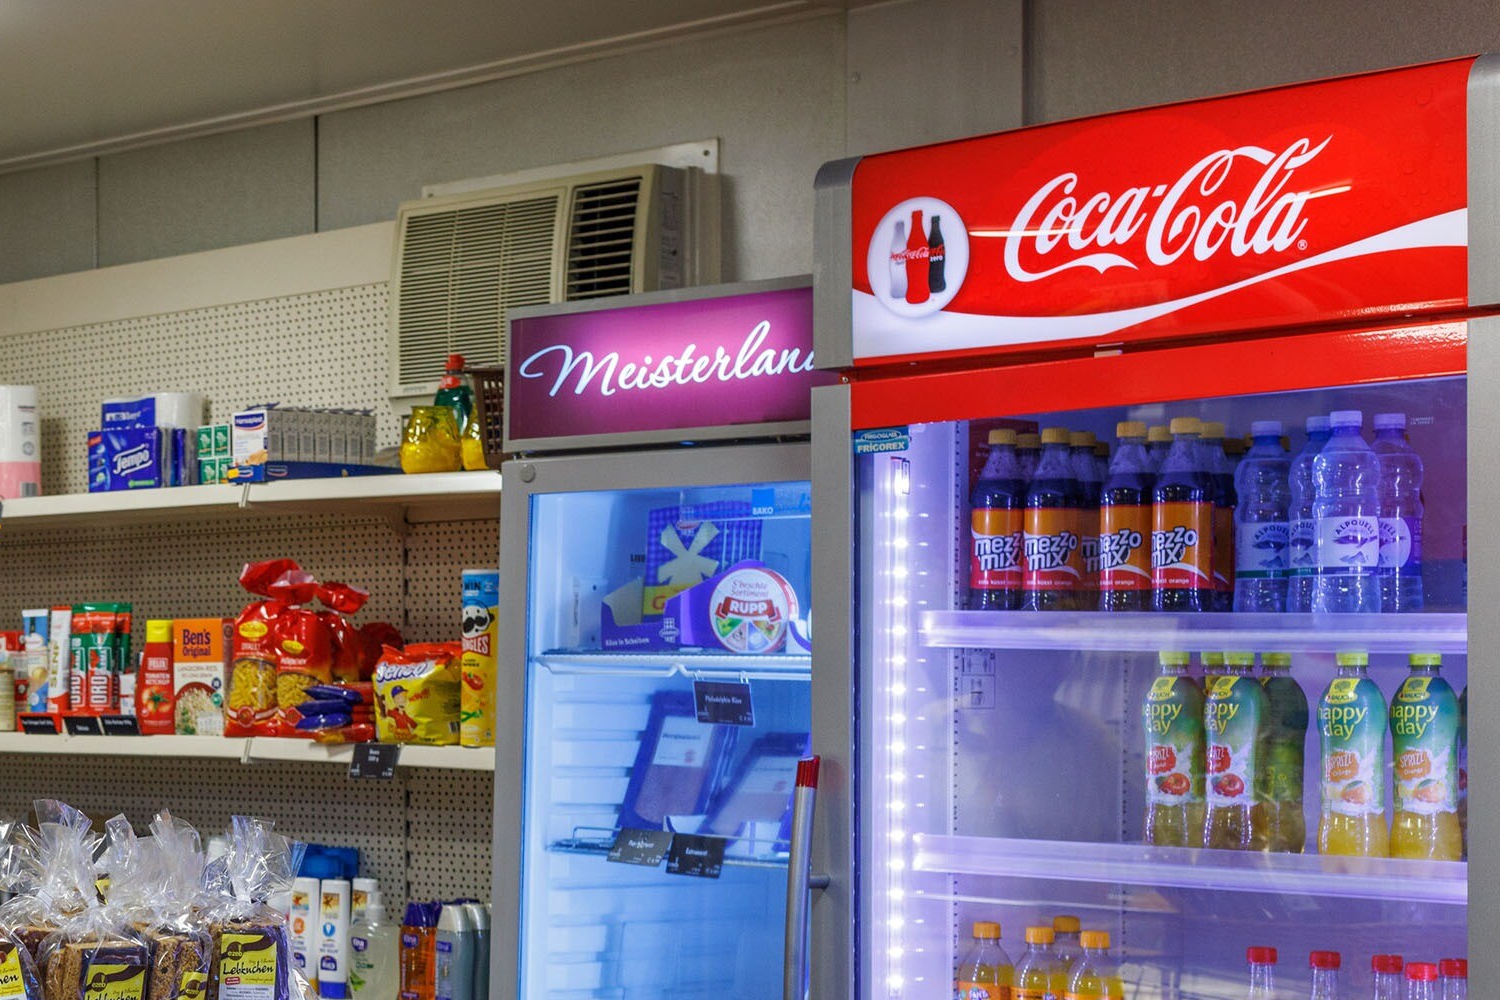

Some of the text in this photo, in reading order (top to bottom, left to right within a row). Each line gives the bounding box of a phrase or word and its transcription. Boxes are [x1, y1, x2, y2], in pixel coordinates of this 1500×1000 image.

[1004, 134, 1334, 283] Coca-Cola
[857, 441, 905, 454] FRIGOREX
[113, 446, 152, 475] Tempo
[752, 506, 774, 516] BAKO
[975, 532, 1024, 555] mezz
[1024, 531, 1078, 555] mezzo
[980, 551, 1017, 571] mix
[1028, 551, 1068, 571] mix
[729, 600, 768, 615] RUPP
[182, 628, 211, 646] Ben's
[1325, 721, 1356, 741] day
[1395, 719, 1427, 739] day
[222, 960, 275, 976] Lebkuchen
[91, 981, 106, 989] ezeb
